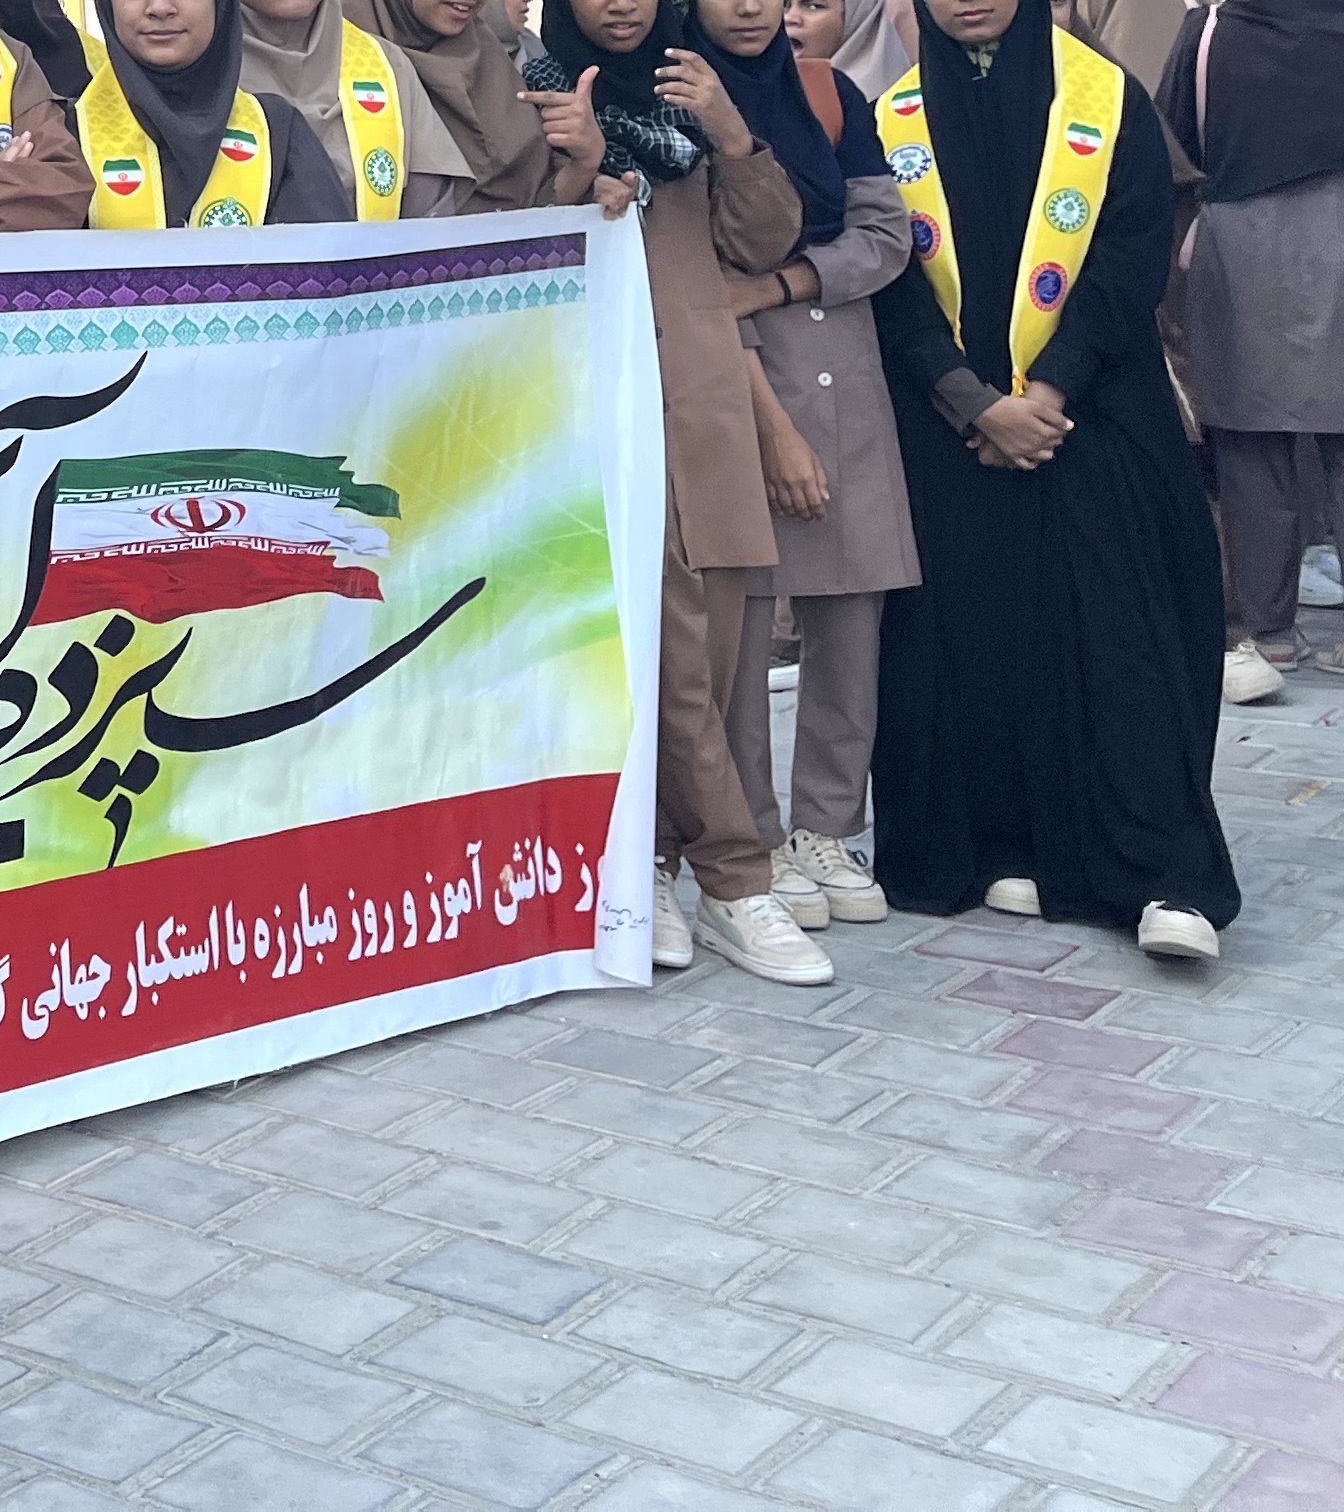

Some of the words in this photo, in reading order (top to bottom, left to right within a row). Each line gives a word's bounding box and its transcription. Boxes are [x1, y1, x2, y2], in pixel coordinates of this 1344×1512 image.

[348, 887, 395, 961] روز
[402, 890, 419, 948] و
[425, 840, 483, 945] آموز
[493, 836, 563, 926] دانش
[120, 905, 220, 1018] استکبار
[224, 900, 248, 983] با
[253, 882, 338, 979] مبارزه
[21, 938, 112, 1040] جهانی
